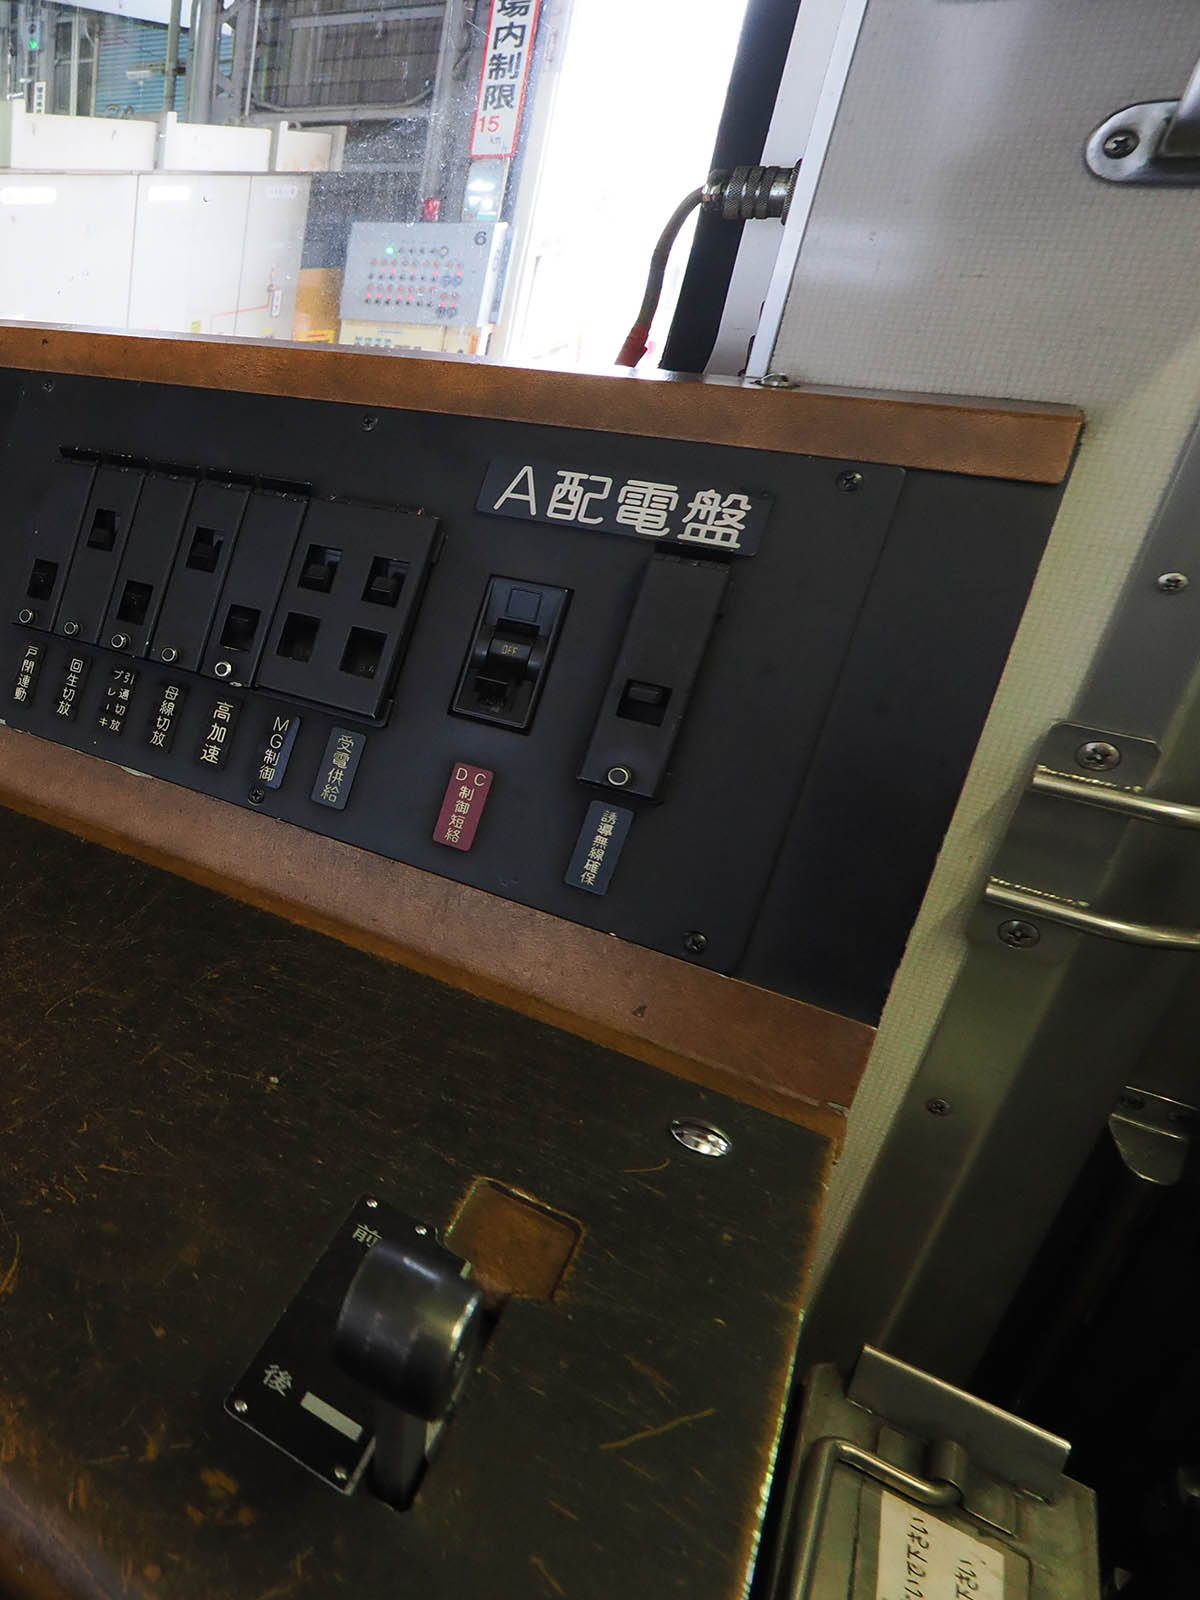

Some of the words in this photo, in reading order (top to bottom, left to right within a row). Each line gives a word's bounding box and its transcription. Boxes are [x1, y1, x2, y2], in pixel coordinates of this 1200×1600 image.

[482, 0, 530, 111] 場内制限
[479, 115, 501, 132] 15
[474, 231, 487, 245] 6
[493, 465, 752, 549] A配電盤
[13, 645, 39, 702] 戸閉連動
[56, 658, 84, 717] 回生切放
[149, 685, 180, 748] 母線切放
[199, 700, 235, 765] 高加速
[259, 716, 290, 783] MG制御
[320, 734, 355, 803] 受電供給
[455, 767, 487, 788] DC
[444, 785, 475, 844] 制御短絡
[580, 809, 618, 887] 誘導無線確保
[351, 1223, 383, 1248] 前
[262, 1364, 294, 1398] 後
[903, 1516, 930, 1600] いで下さい
